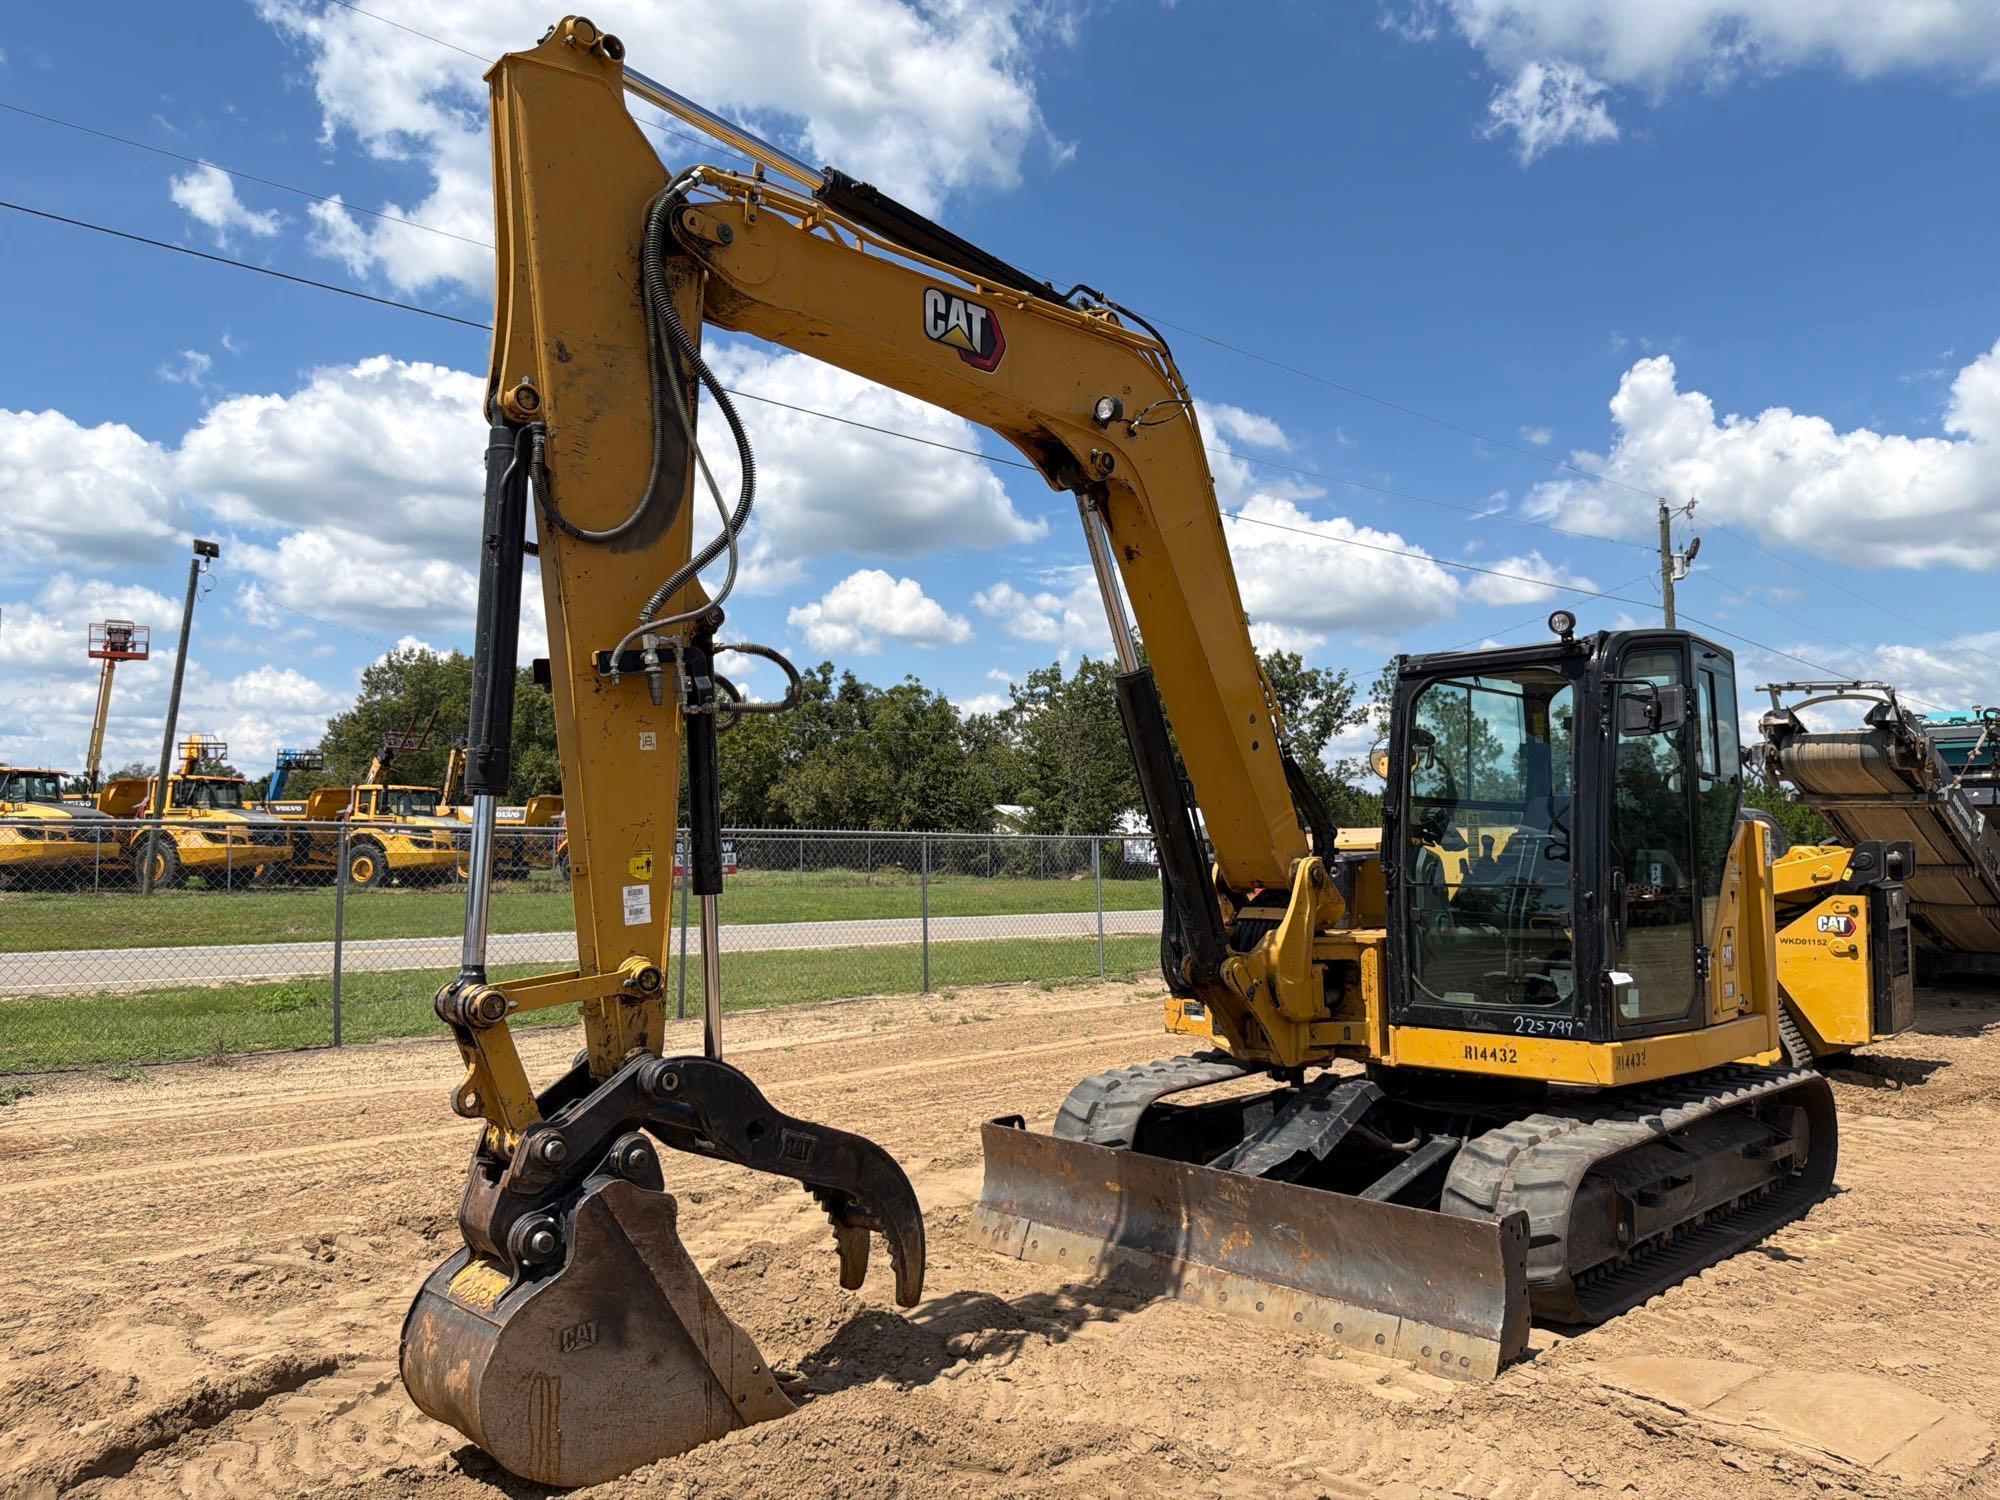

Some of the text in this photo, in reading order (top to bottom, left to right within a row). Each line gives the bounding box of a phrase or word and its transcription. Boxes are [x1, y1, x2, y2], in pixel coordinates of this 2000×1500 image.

[925, 288, 987, 354] CAT
[1817, 915, 1847, 933] CAT
[1780, 937, 1827, 946] WKD01152
[1513, 1016, 1573, 1036] 225799
[561, 1321, 598, 1352] CAT
